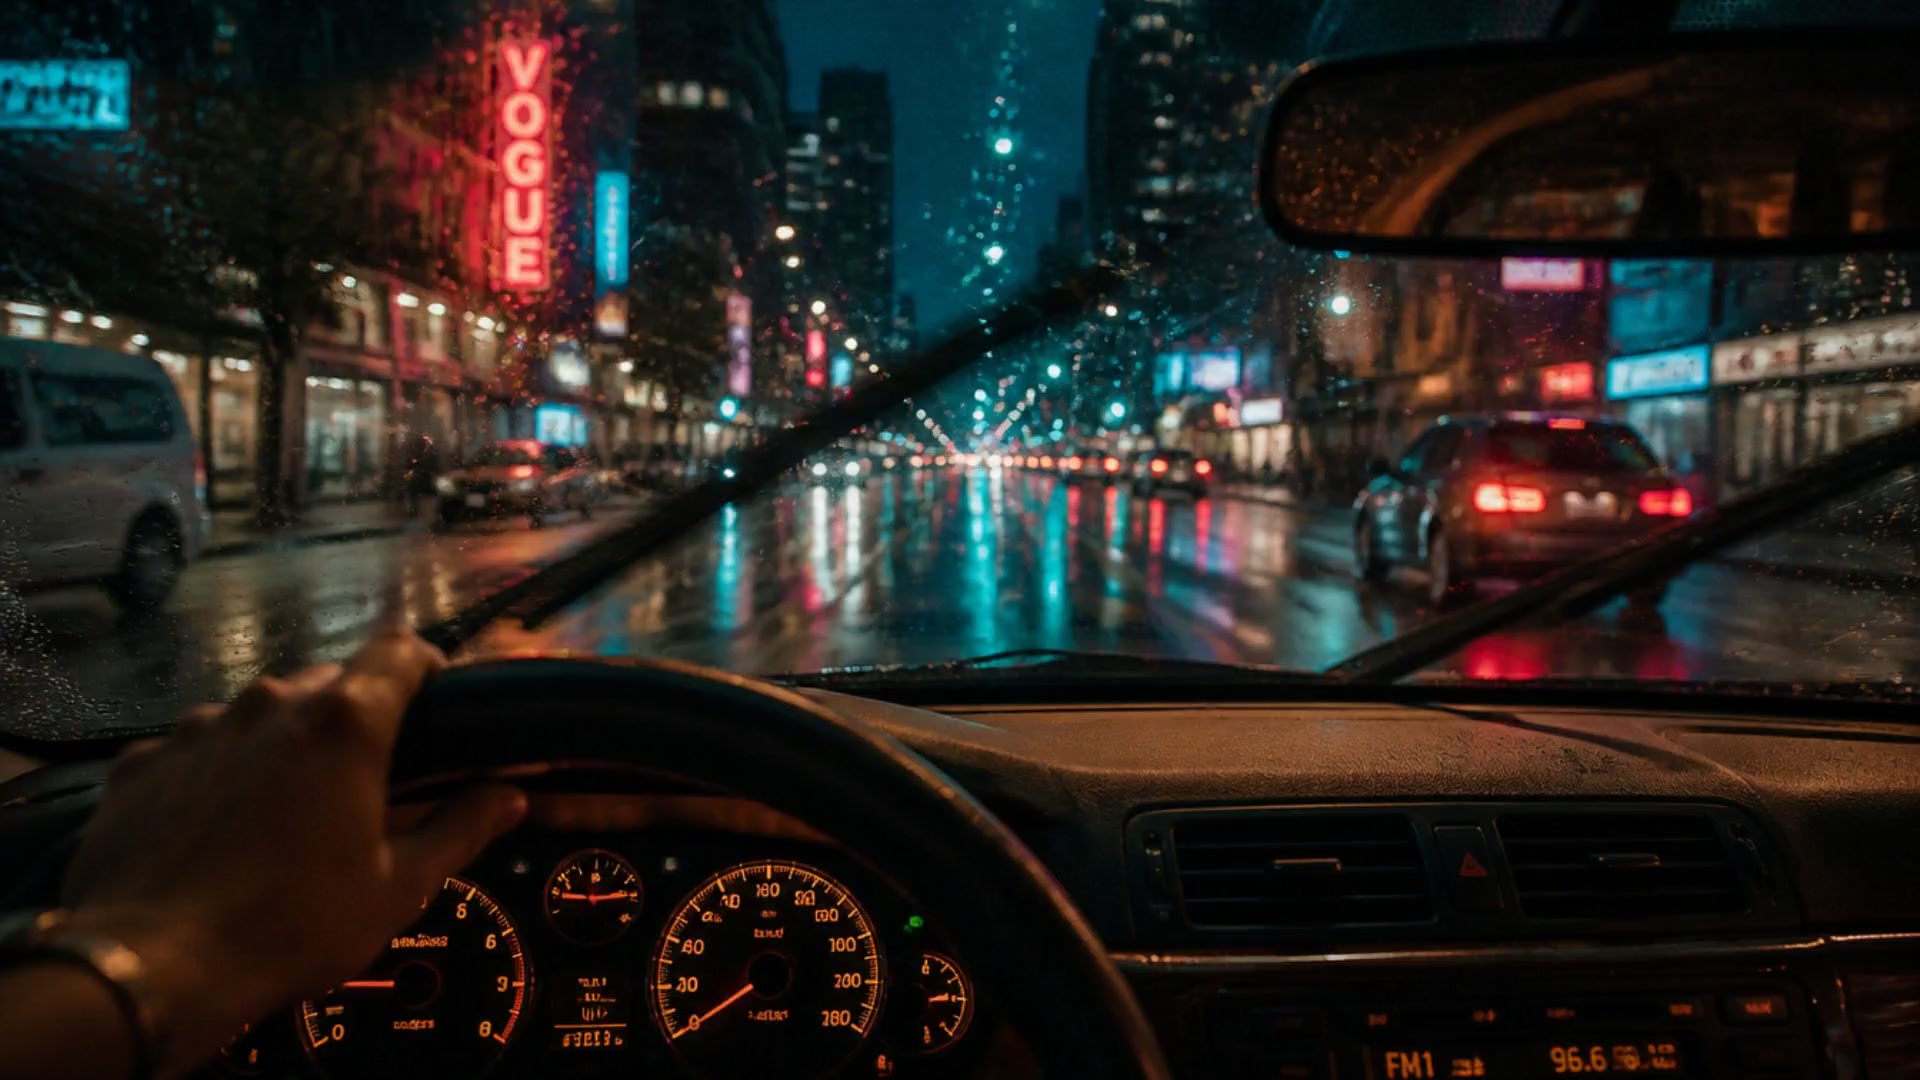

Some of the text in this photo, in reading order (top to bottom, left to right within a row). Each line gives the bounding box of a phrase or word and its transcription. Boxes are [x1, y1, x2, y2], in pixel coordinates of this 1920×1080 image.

[502, 44, 546, 285] VOGUE
[485, 933, 497, 950] 6
[332, 1023, 345, 1040] 0
[1384, 1050, 1435, 1079] FM1
[1550, 1046, 1607, 1074] 96.6
